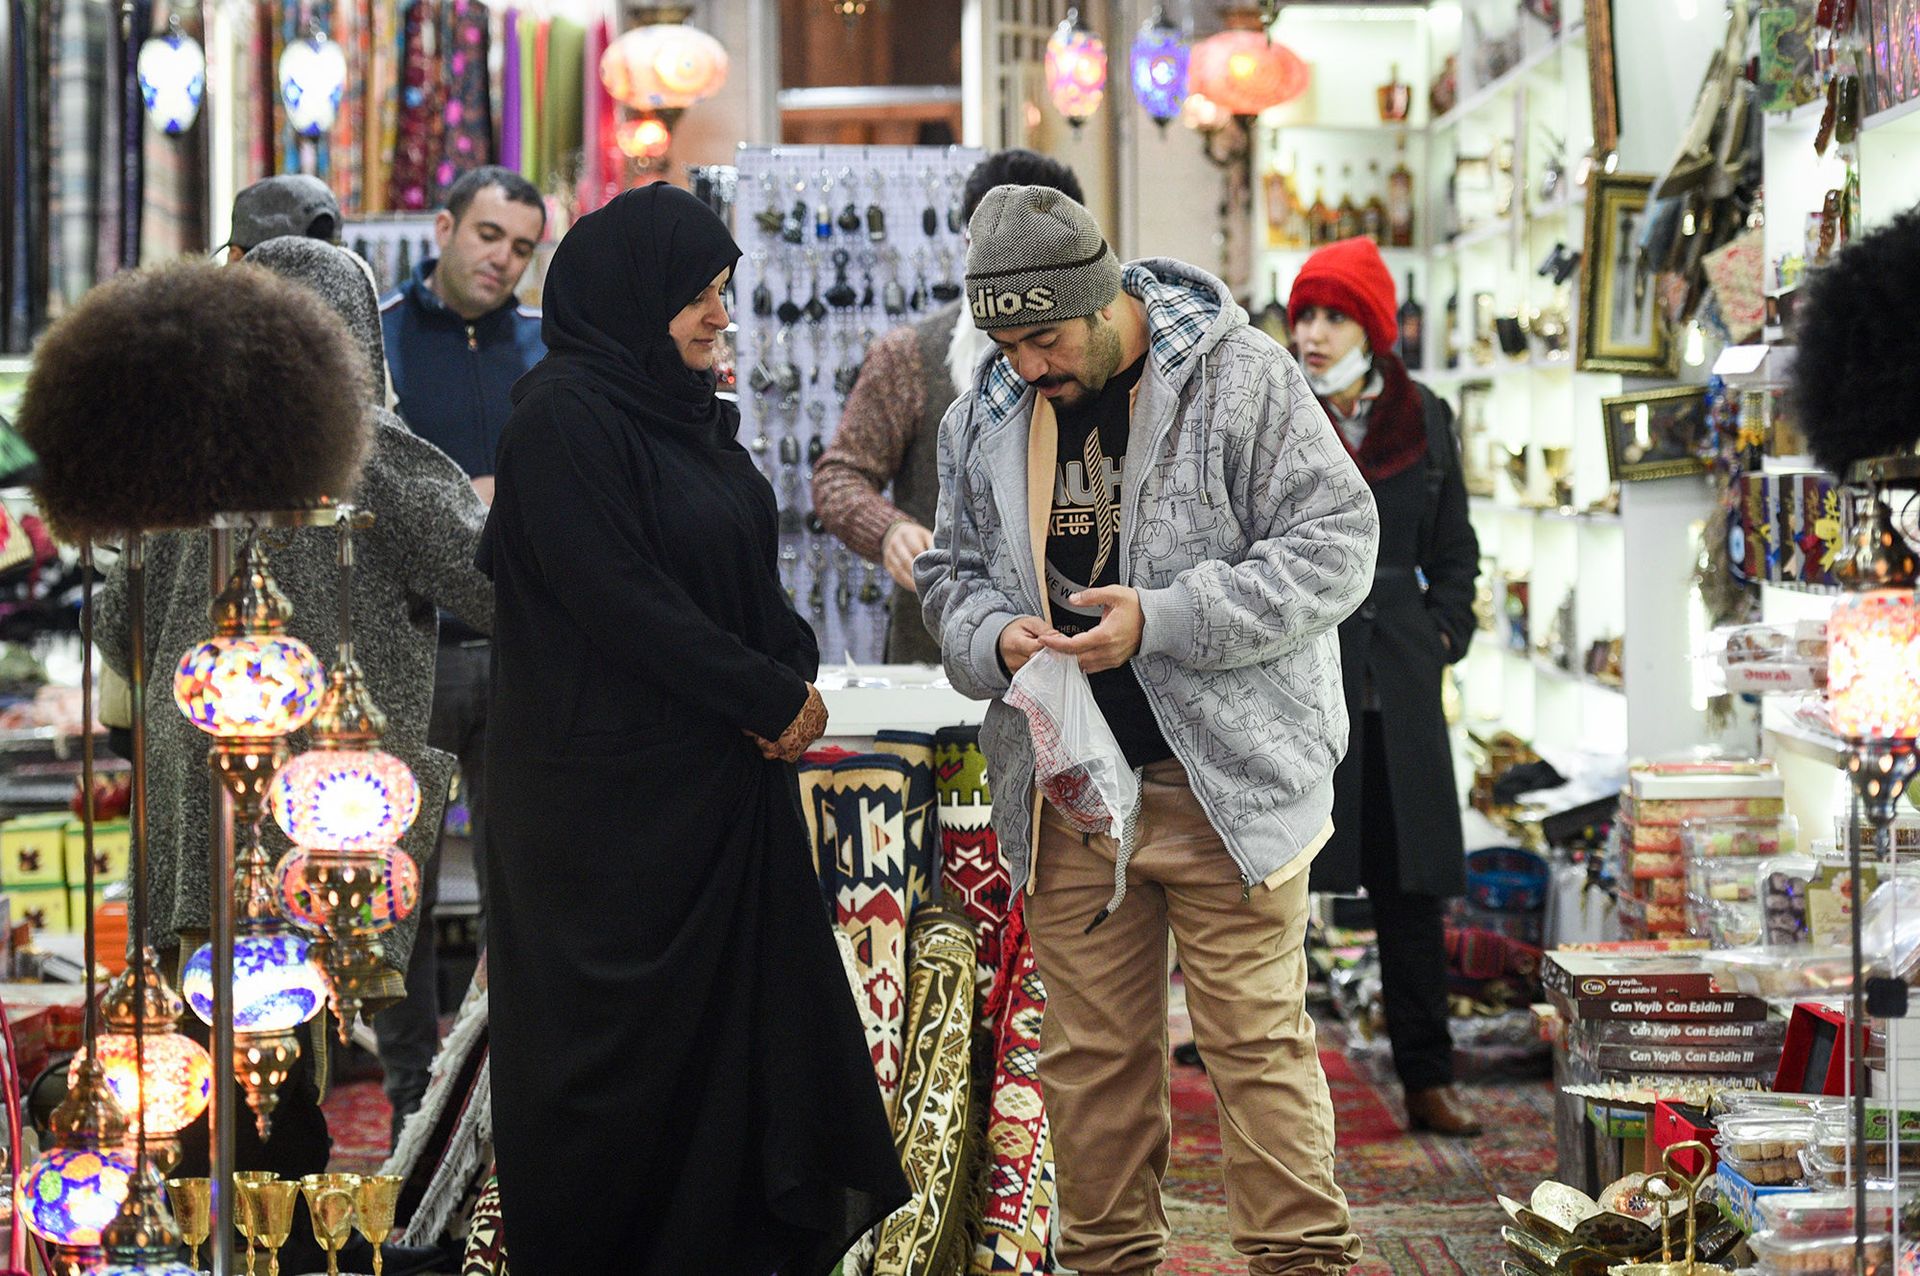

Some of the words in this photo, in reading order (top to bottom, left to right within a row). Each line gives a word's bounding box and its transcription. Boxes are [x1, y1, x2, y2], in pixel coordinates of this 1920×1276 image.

[1069, 513, 1090, 535] US
[1584, 983, 1603, 992] Can
[1611, 1002, 1632, 1013] Can
[1633, 1002, 1663, 1015] Yeyib
[1666, 1002, 1688, 1013] Can
[1689, 1001, 1722, 1014] Eşidin
[1630, 1026, 1651, 1037] Can
[1652, 1026, 1681, 1038] Yeyib
[1685, 1026, 1707, 1037] Can
[1708, 1025, 1741, 1037] Eşidin
[1630, 1051, 1651, 1062] Can
[1652, 1051, 1682, 1063] Yeyib
[1685, 1051, 1707, 1062] Can
[1708, 1051, 1742, 1063] Eşidin
